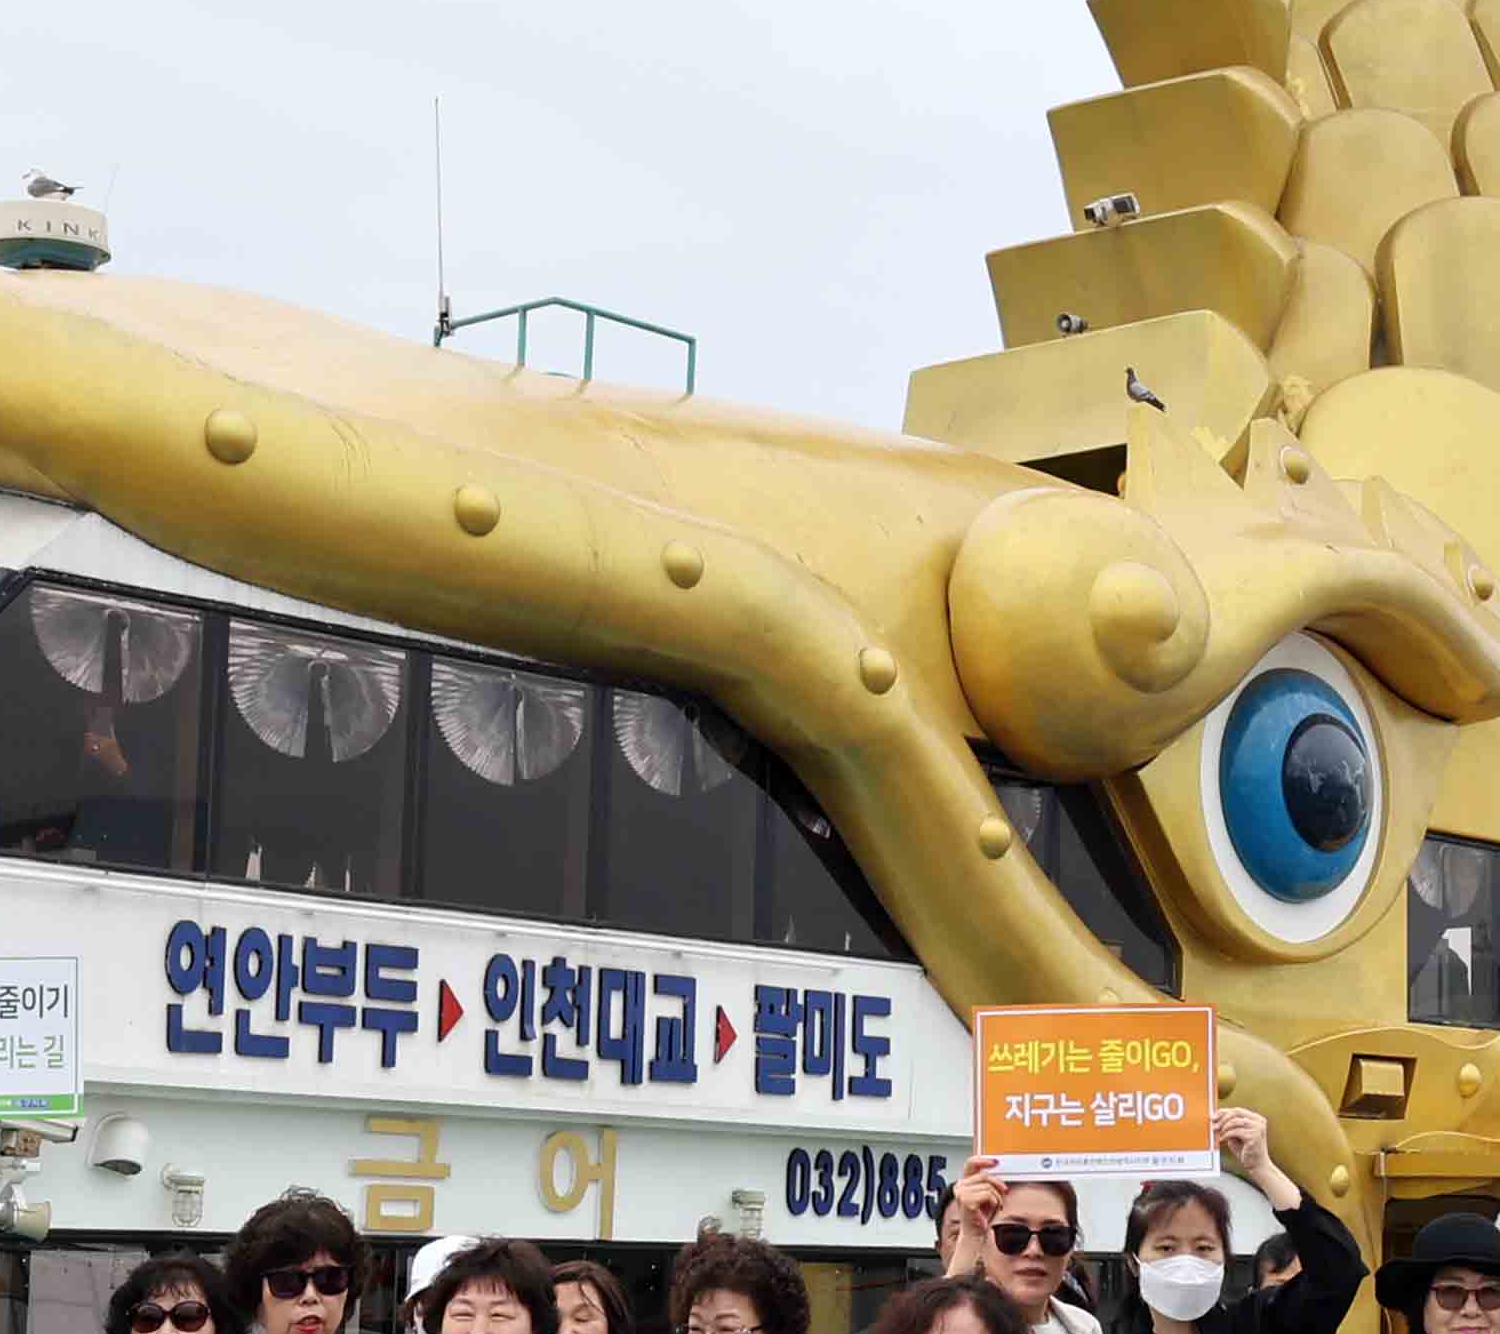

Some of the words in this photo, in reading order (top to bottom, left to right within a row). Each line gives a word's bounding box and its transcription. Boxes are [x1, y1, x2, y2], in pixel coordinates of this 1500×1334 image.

[165, 919, 419, 1068] 연안부두
[484, 953, 698, 1085] 인천대교
[754, 985, 893, 1100] 팔미도
[45, 1035, 65, 1068] 길
[989, 1041, 1092, 1075] 쓰레기는
[1099, 1040, 1200, 1075] 줄이GO,
[1005, 1093, 1084, 1128] 지구는
[1091, 1092, 1183, 1128] 살리GO
